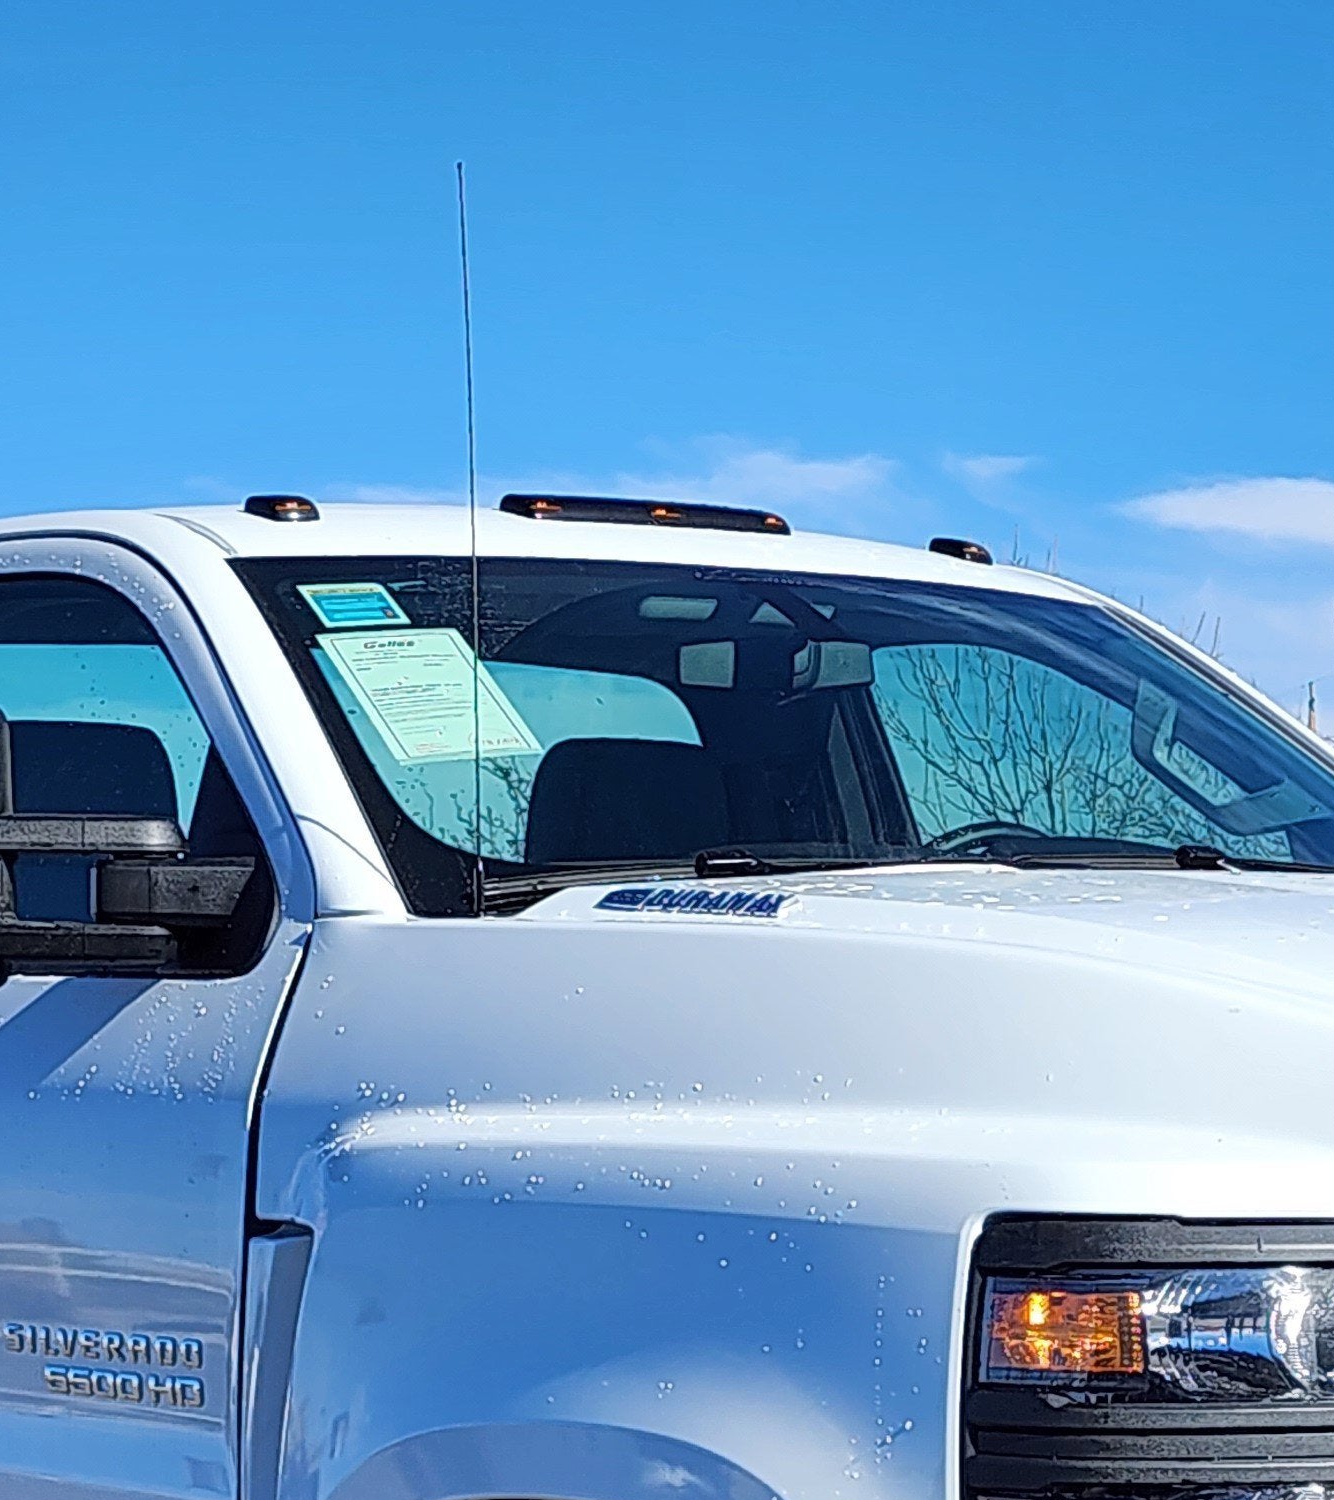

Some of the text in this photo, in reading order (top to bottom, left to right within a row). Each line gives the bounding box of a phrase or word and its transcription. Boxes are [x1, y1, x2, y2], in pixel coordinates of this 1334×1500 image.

[643, 887, 797, 918] DURAMAX
[2, 1323, 204, 1369] SILVERADO
[43, 1363, 206, 1409] 5500 HD
